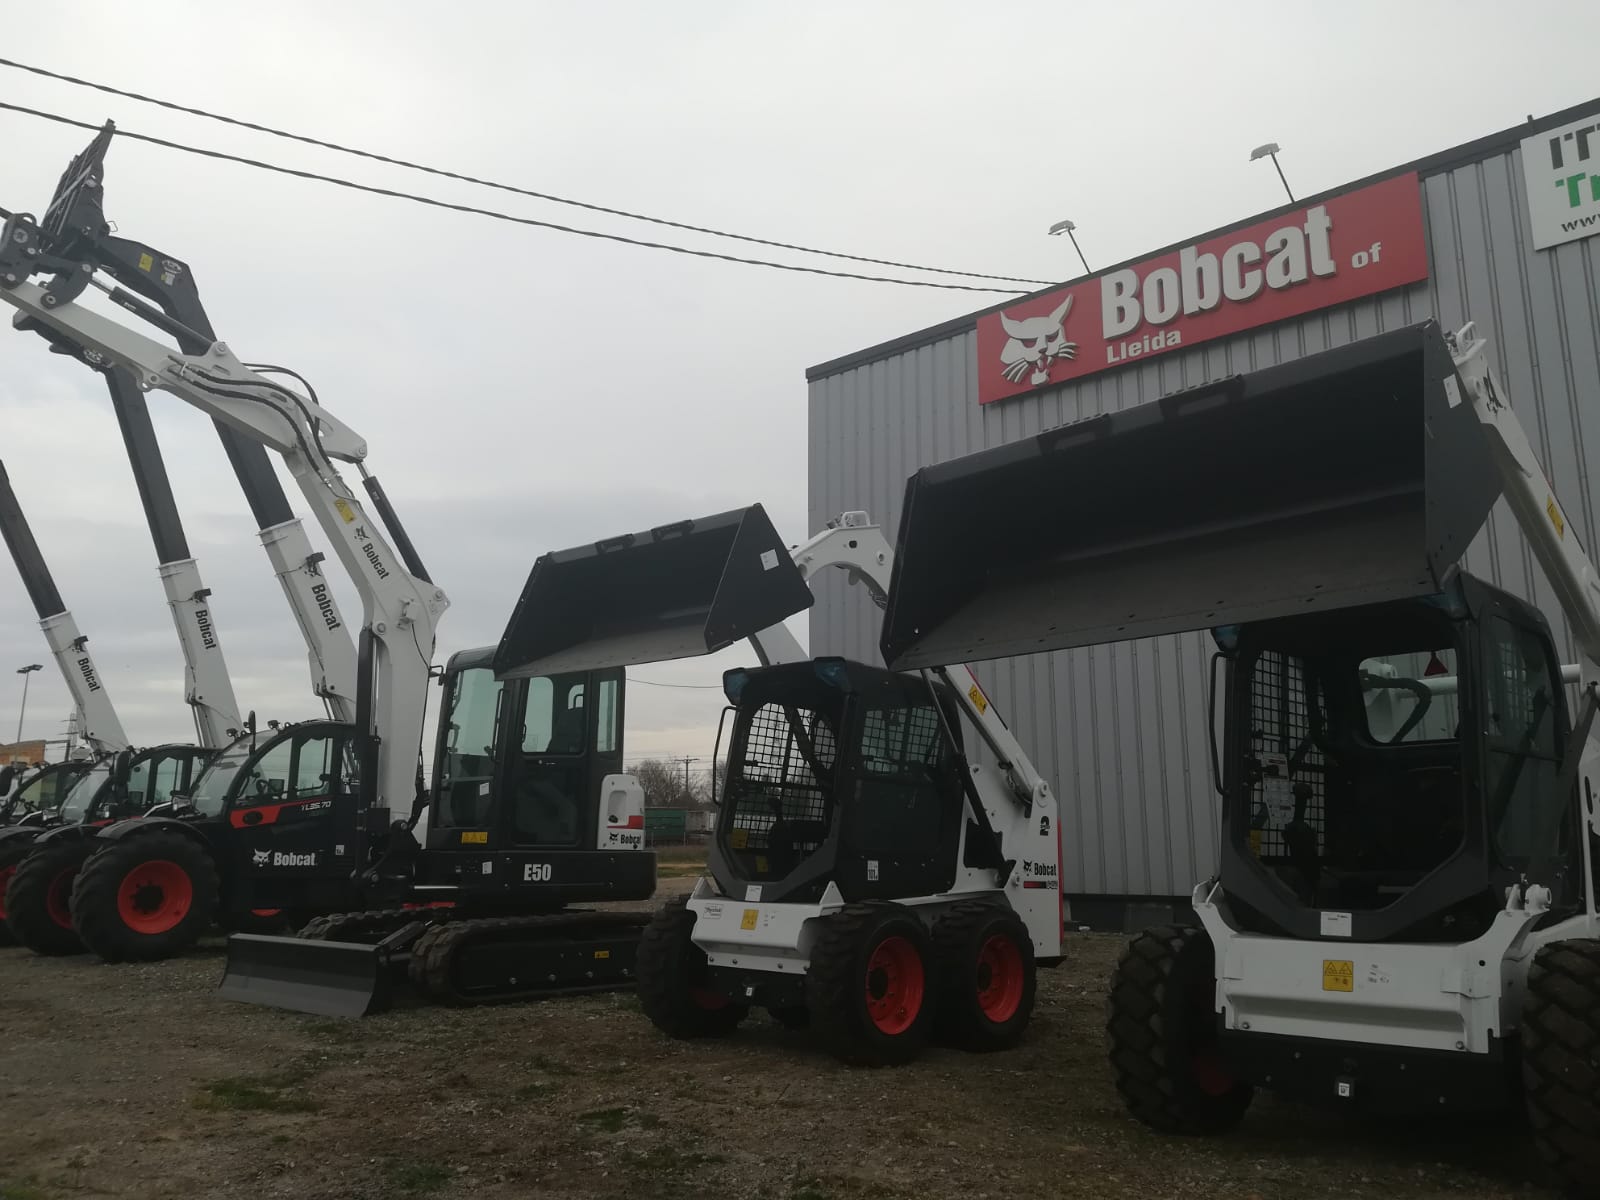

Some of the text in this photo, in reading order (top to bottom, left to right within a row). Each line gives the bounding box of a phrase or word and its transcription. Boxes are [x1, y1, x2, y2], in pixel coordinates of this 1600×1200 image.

[1549, 123, 1600, 169] IT
[1561, 213, 1600, 232] ww
[1101, 204, 1382, 340] Bobcat of
[1106, 330, 1182, 364] Lleida
[362, 542, 390, 580] Bobcat
[311, 583, 341, 631] Bobcat
[195, 609, 217, 650] Bobcat
[78, 657, 101, 693] Bobcat
[273, 851, 316, 867] Bobcat
[523, 863, 552, 882] E50
[1034, 862, 1057, 876] Bobcat
